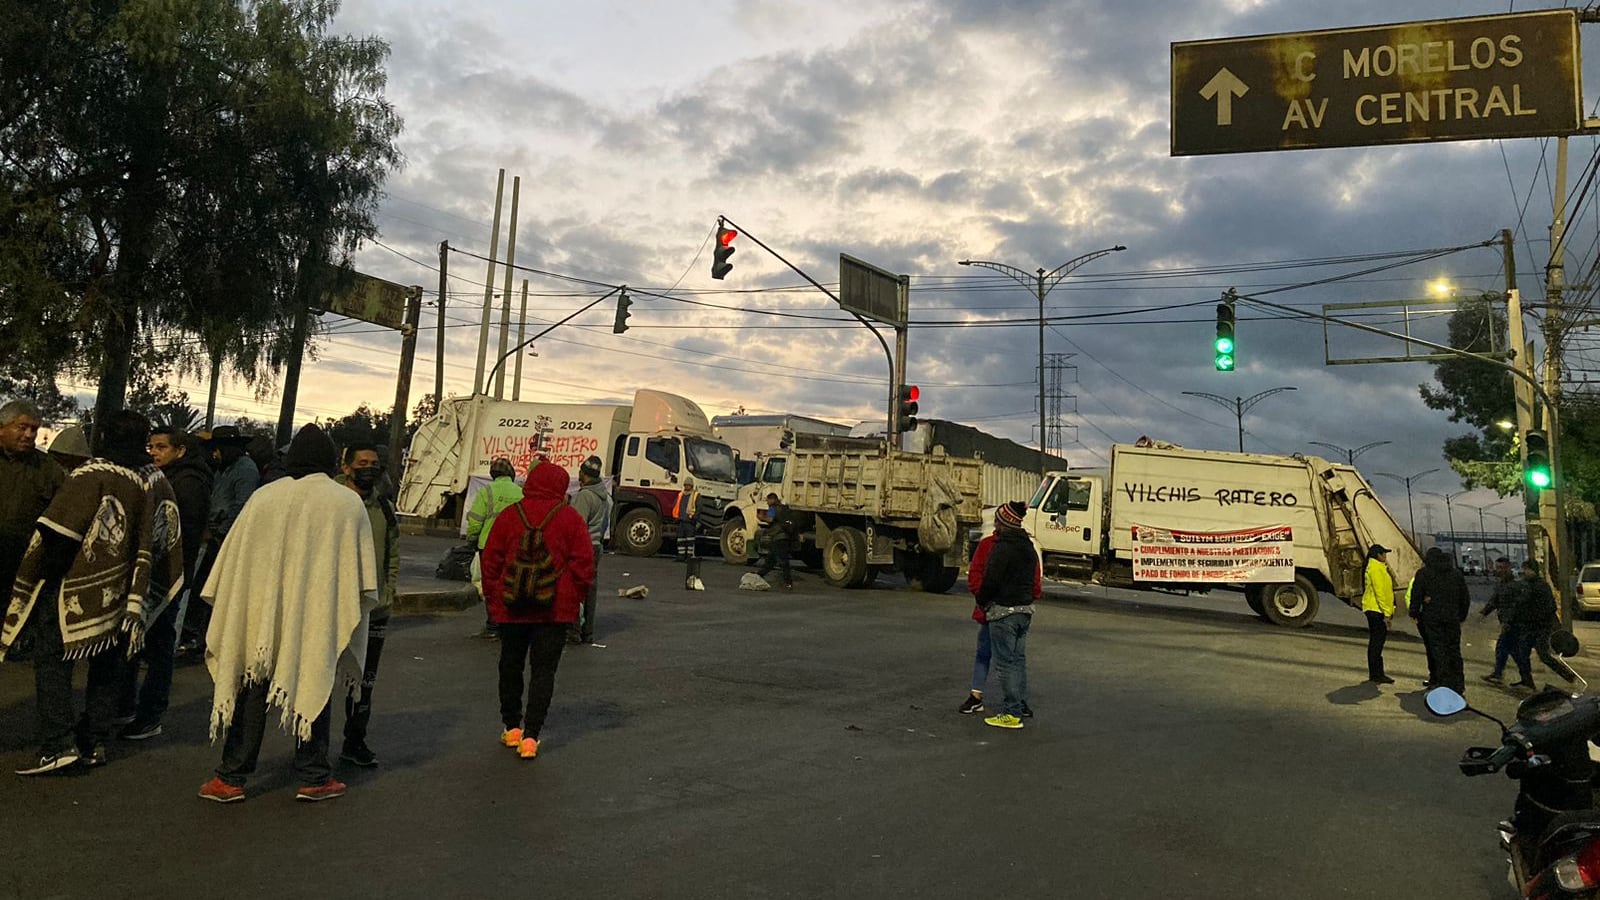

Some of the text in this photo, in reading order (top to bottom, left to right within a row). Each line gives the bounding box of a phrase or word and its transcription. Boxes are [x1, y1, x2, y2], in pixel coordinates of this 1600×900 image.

[1295, 34, 1524, 82] C MORELOS
[1281, 83, 1537, 130] AV CENTRAL
[498, 418, 593, 431] 2022 2024
[1125, 482, 1298, 507] VILCHIS RATERO
[1140, 545, 1189, 555] CUMPLIMIENTO
[1232, 546, 1281, 555] PRESTACIONES
[1140, 557, 1187, 567] IMPLEMENTOS
[1197, 559, 1234, 567] SEGURIDAD
[1140, 569, 1159, 578] PAGO
[1170, 570, 1191, 578] FONDO
